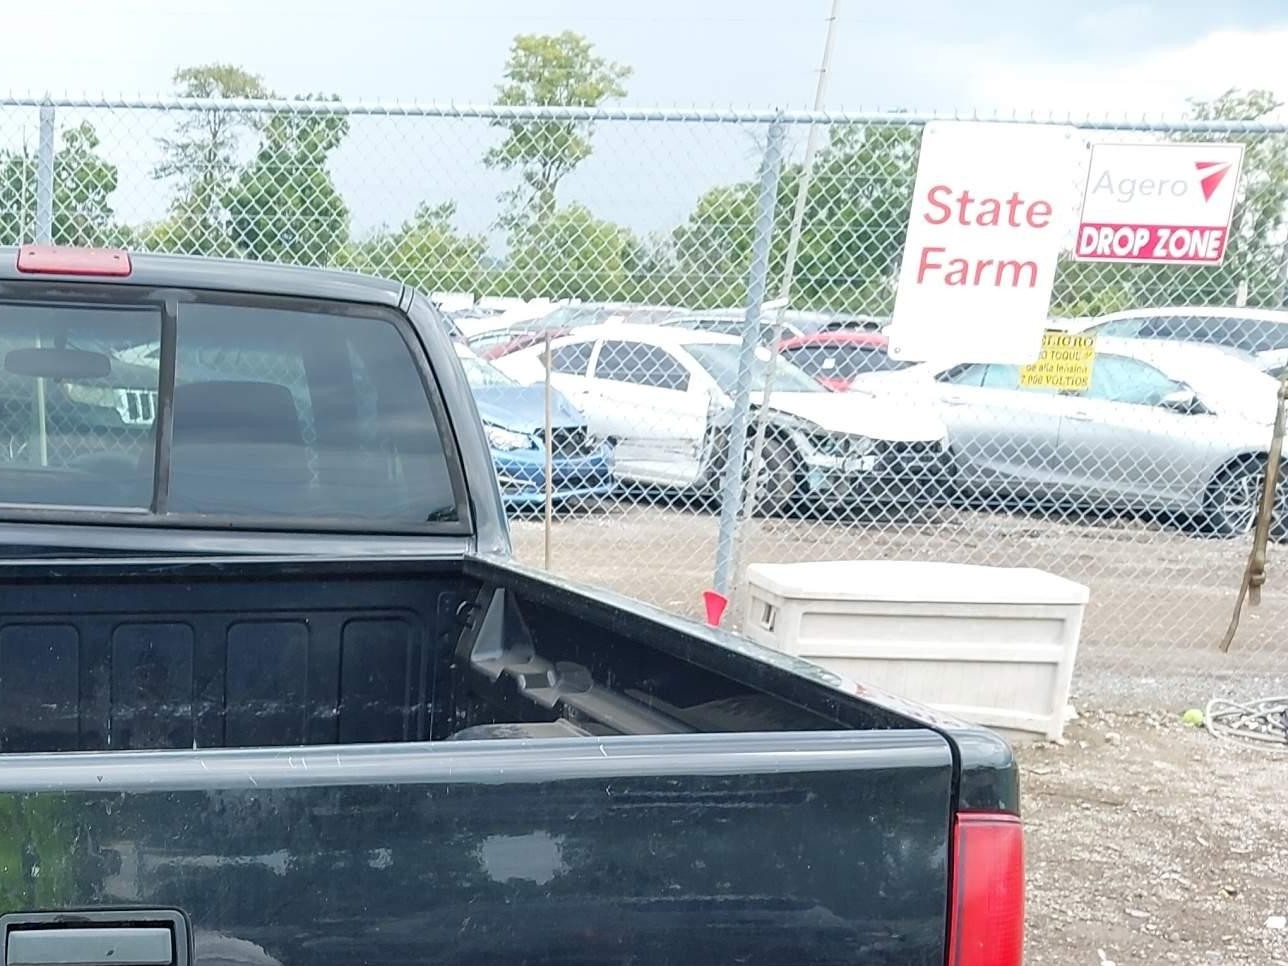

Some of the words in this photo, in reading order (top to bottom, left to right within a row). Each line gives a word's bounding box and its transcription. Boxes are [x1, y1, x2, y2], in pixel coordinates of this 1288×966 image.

[1091, 169, 1188, 203] Agero
[923, 185, 1053, 228] State
[1079, 226, 1150, 256] DROP
[1152, 229, 1223, 258] ZONE
[916, 246, 1038, 288] Farm
